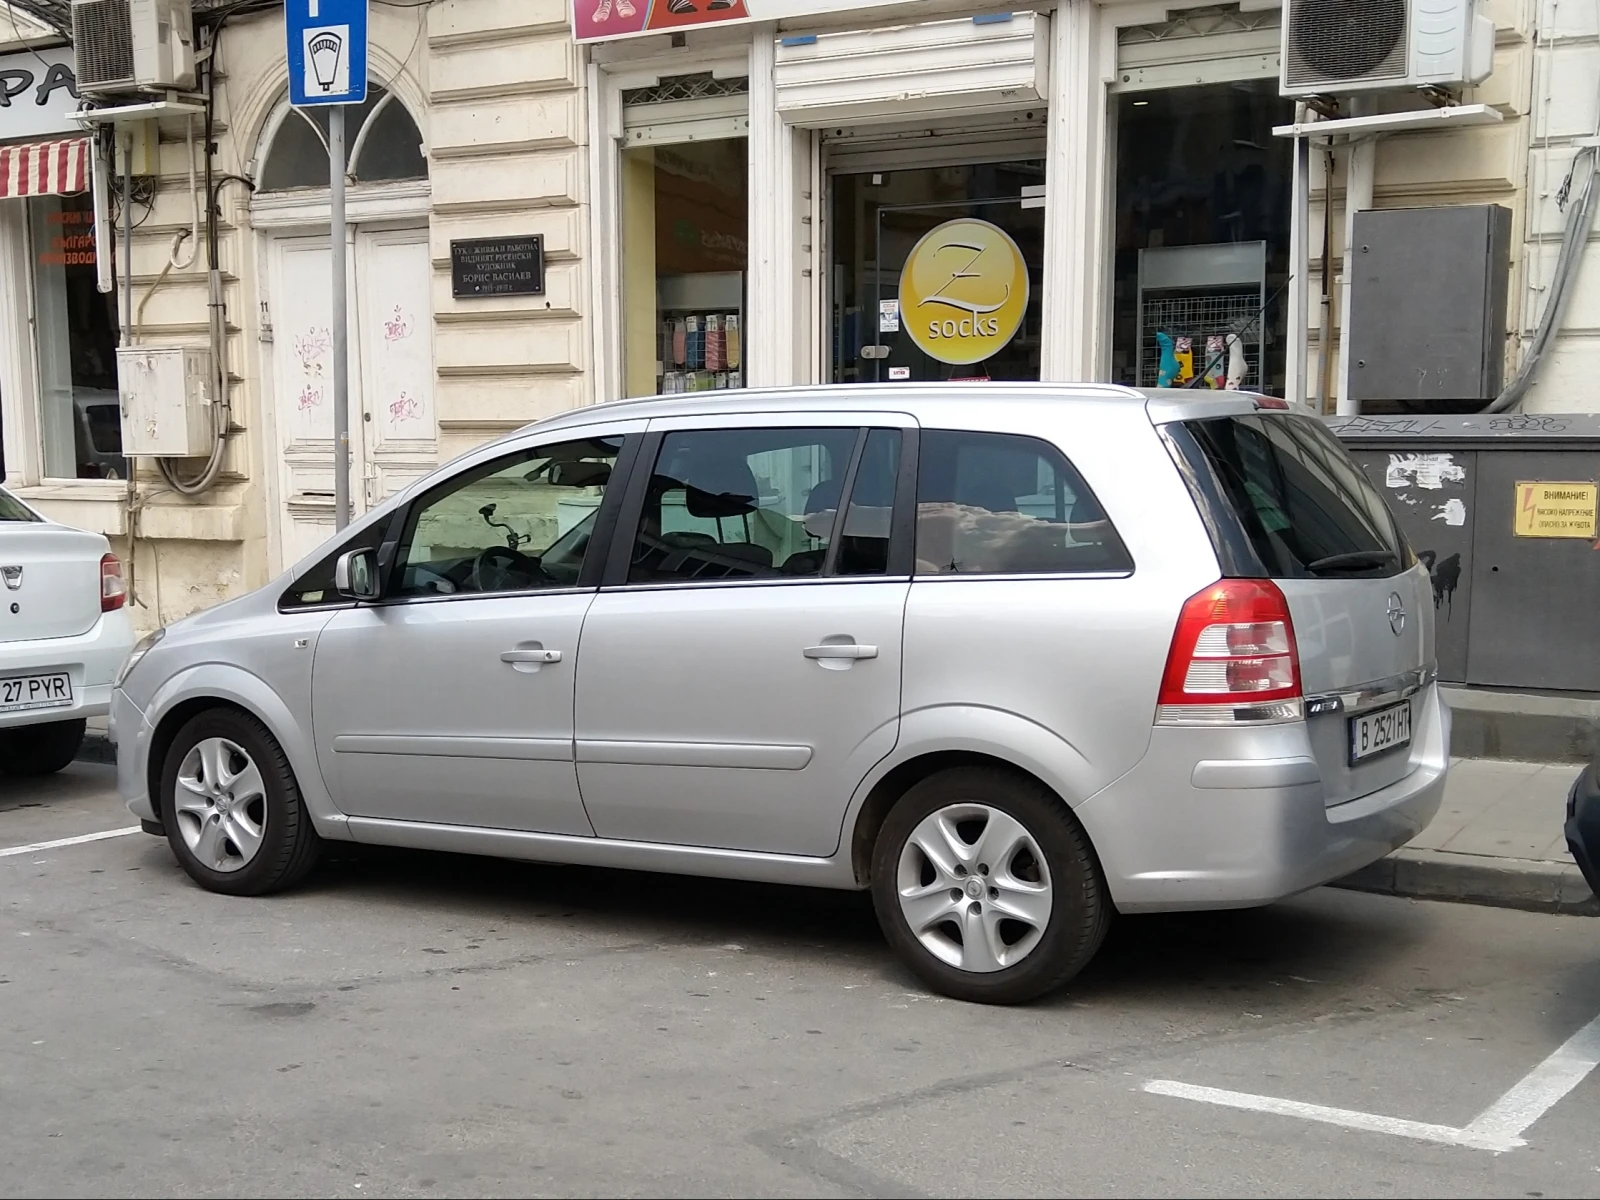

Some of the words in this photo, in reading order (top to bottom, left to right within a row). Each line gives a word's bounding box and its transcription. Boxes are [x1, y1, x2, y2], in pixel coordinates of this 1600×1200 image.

[462, 273, 490, 283] БОРИС
[492, 271, 532, 281] ВАСИЛЕВ
[917, 243, 1010, 314] Z
[260, 301, 269, 313] 11
[928, 314, 998, 340] socks
[1543, 490, 1589, 501] ВНИМАНИЕ!
[1560, 521, 1568, 529] ЗА
[2, 680, 23, 703] 27
[28, 677, 67, 700] PYR
[1361, 721, 1369, 751] B
